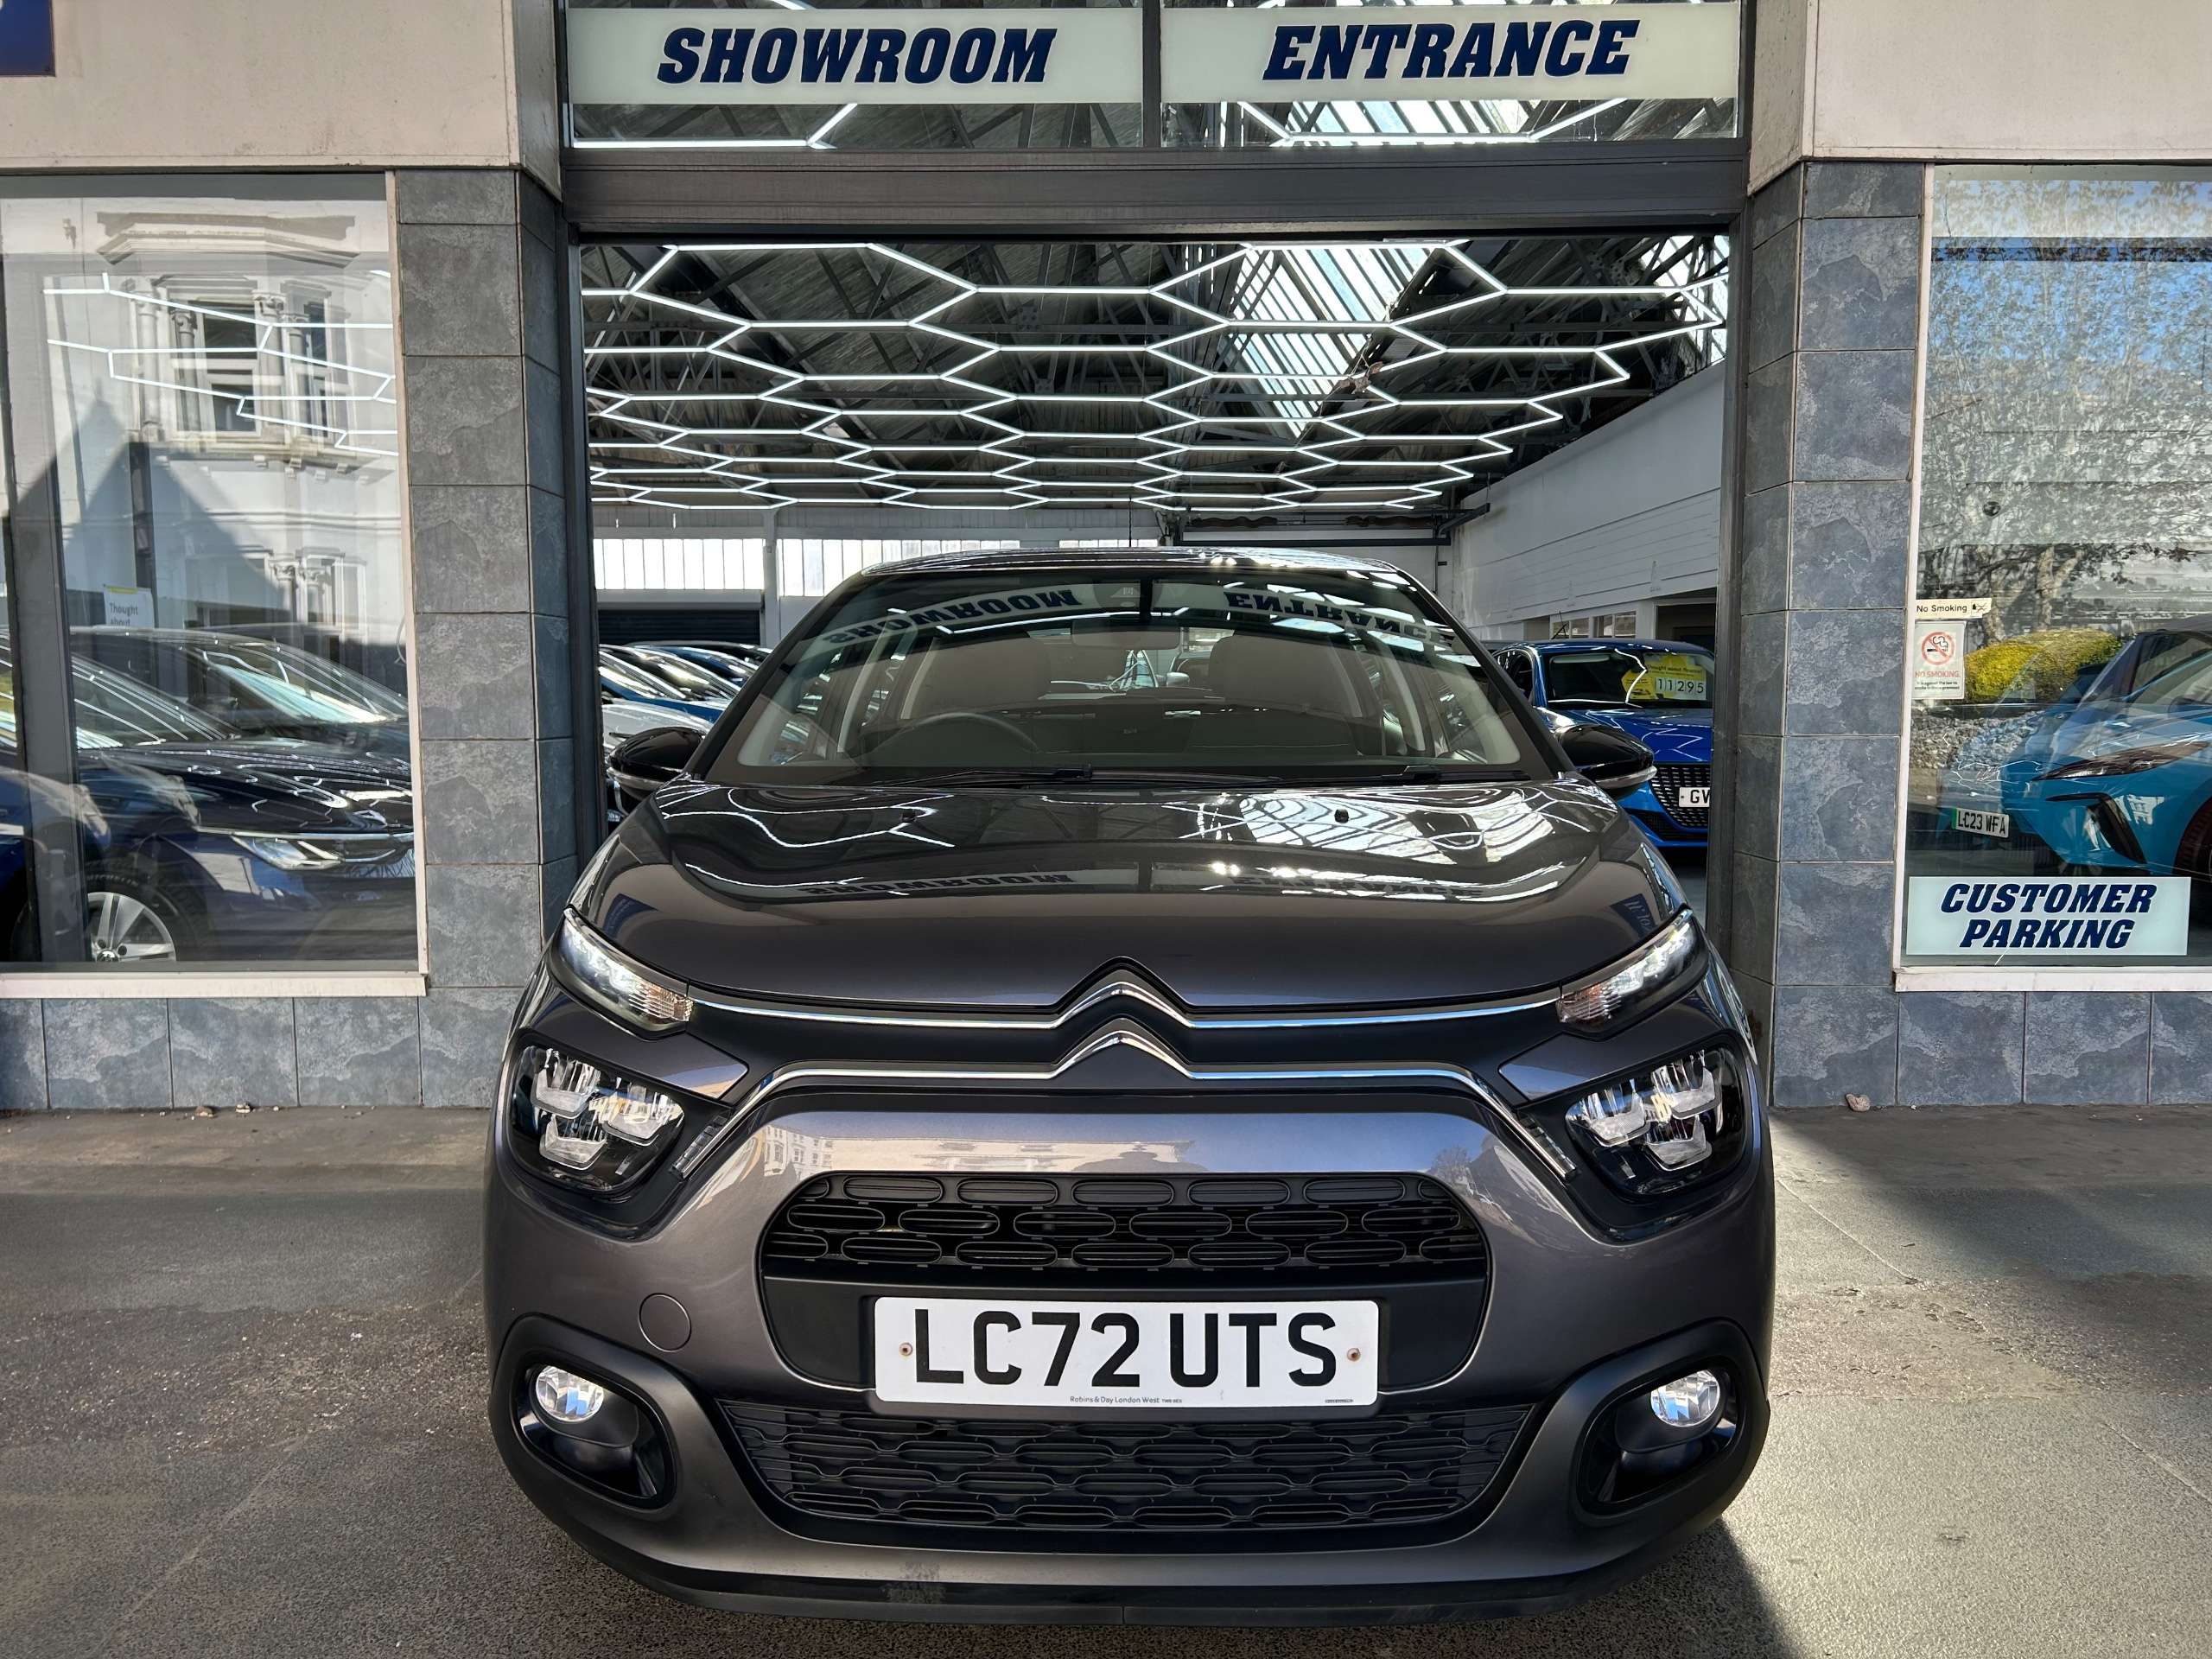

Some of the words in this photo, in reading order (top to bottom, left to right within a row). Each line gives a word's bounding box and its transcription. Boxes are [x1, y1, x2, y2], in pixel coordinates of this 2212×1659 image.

[656, 28, 1058, 84] SHOWROOM
[1262, 19, 1641, 80] ENTRANCE
[109, 602, 138, 616] Thought
[1931, 604, 1967, 613] Smoking
[1657, 678, 1705, 694] 11295
[1690, 789, 1710, 804] GV
[1958, 810, 1983, 830] LC23
[1986, 815, 2005, 834] WFA
[1940, 883, 2158, 913] CUSTOMER
[1959, 918, 2135, 950] PARKING
[914, 1308, 1141, 1387] LC72
[1169, 1312, 1337, 1387] UTS
